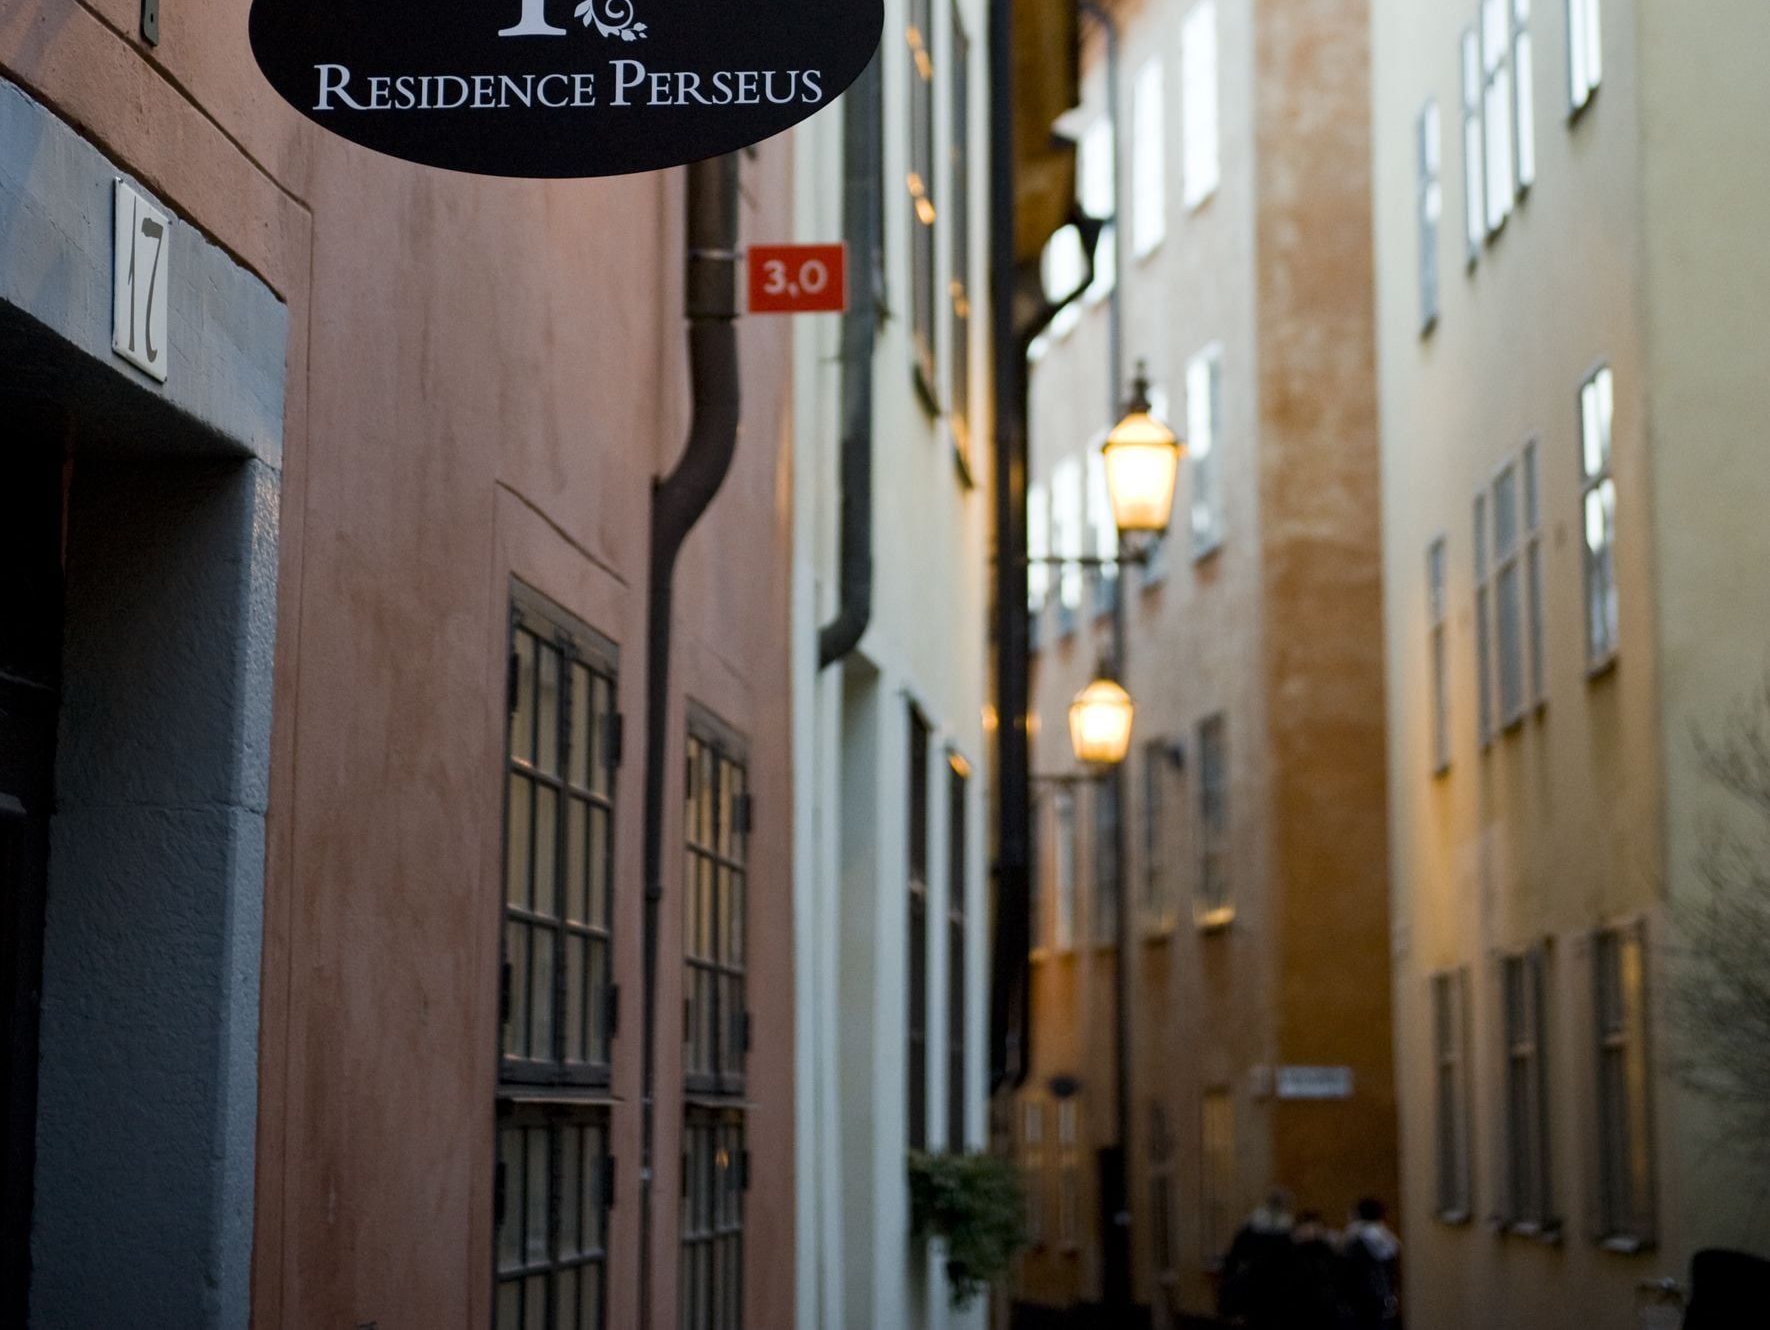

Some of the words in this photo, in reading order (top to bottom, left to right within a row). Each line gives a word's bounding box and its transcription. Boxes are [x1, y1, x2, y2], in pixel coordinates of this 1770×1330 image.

[313, 64, 595, 111] RESIDENCE
[609, 59, 824, 107] PERSEUS
[128, 195, 164, 363] 17
